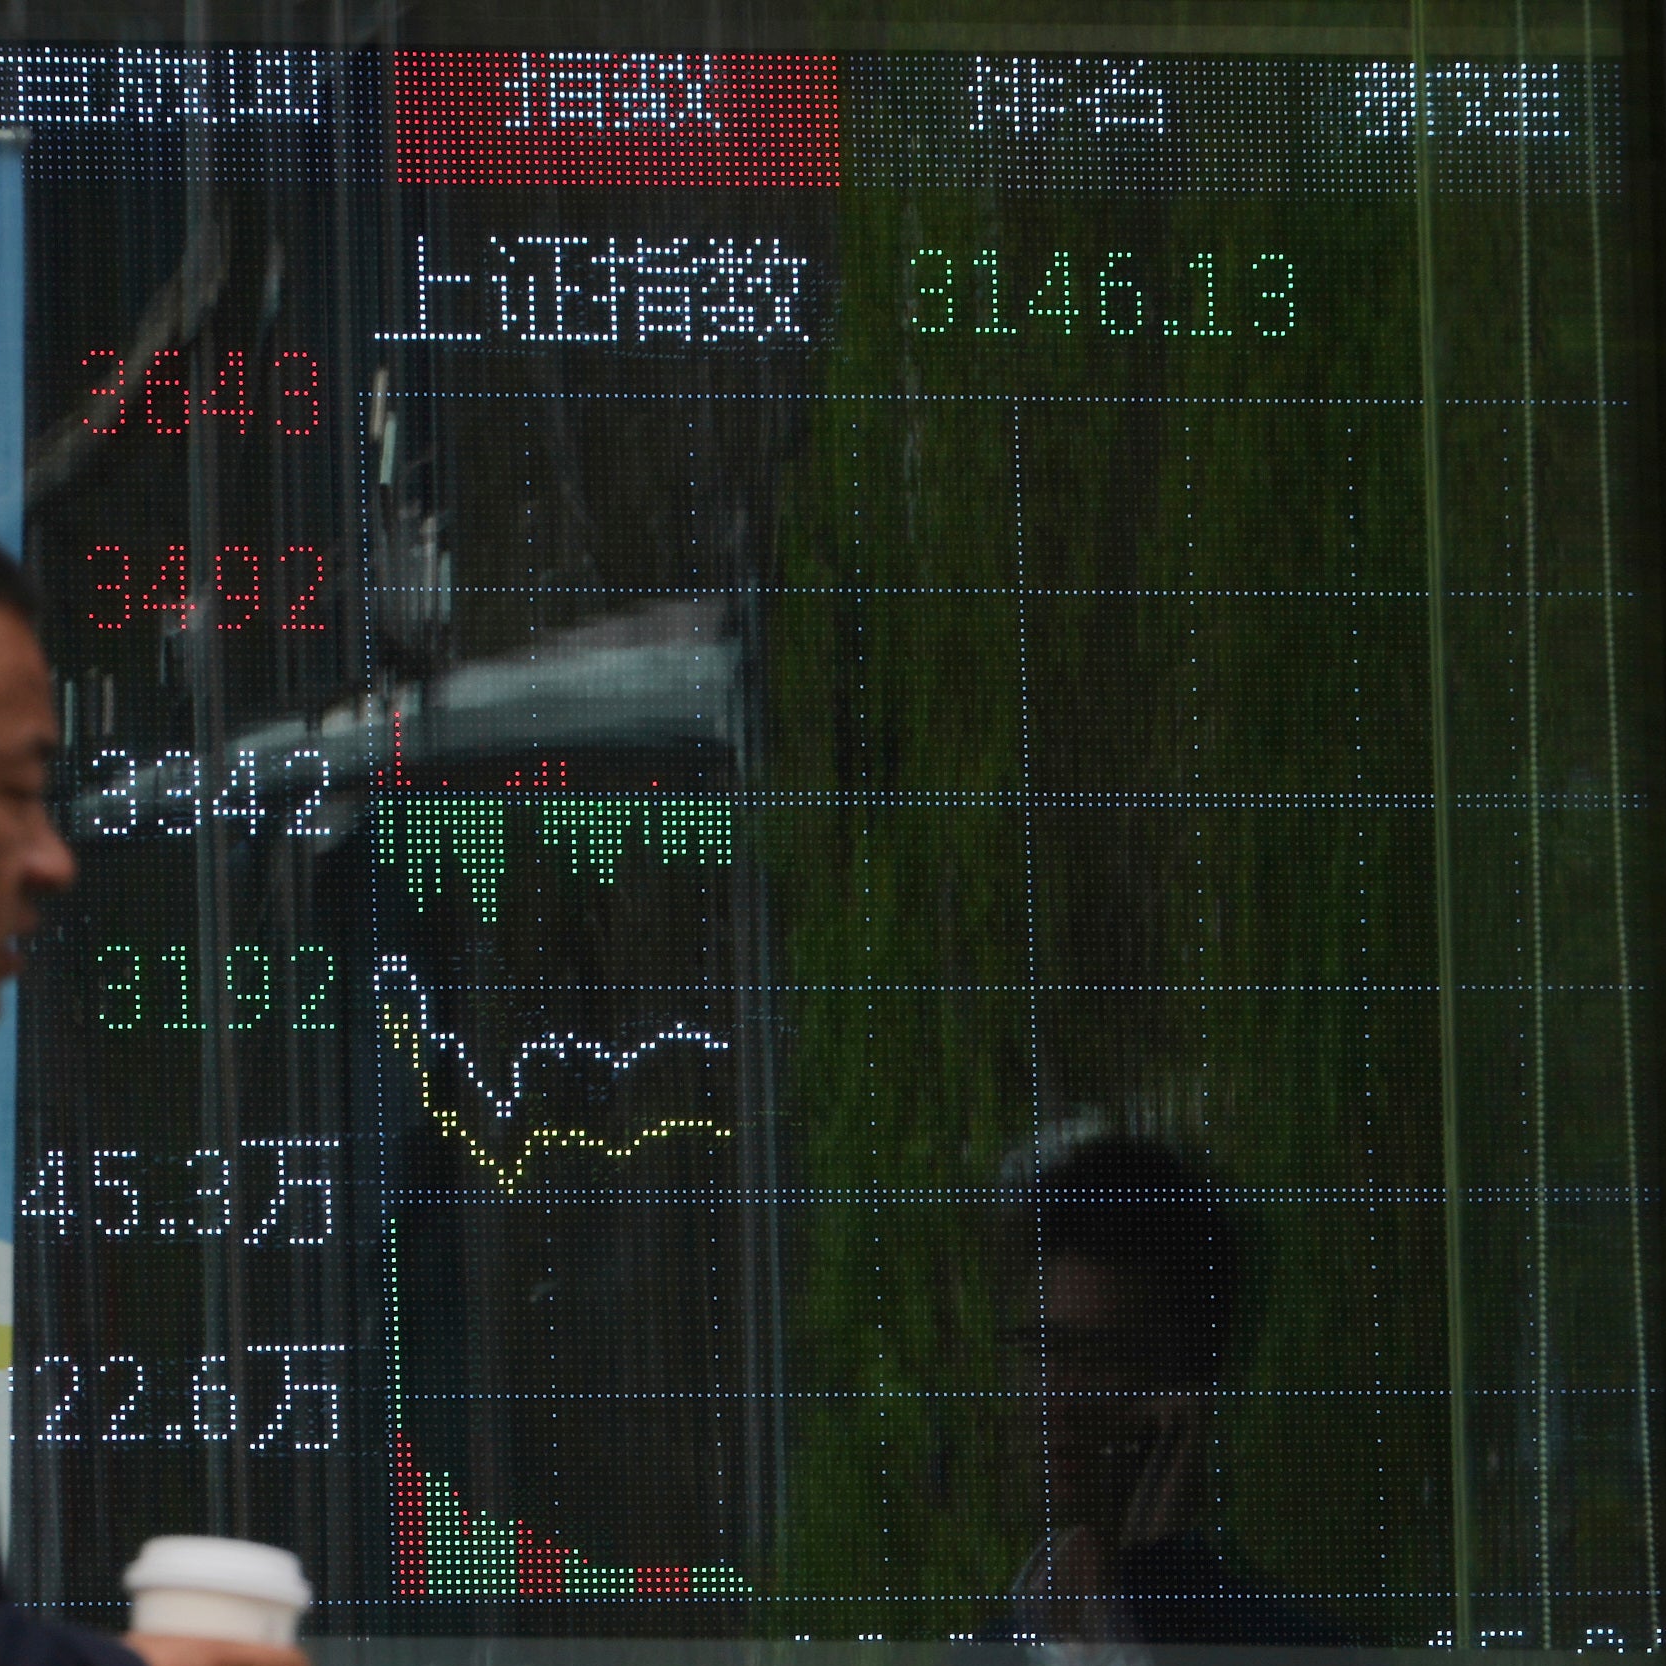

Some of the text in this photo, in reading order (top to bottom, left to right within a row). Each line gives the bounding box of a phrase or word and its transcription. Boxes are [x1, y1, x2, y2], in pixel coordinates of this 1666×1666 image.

[504, 52, 721, 129] 指数
[373, 235, 1297, 343] 上证指数 3146.13
[80, 349, 325, 438] 3643
[86, 547, 327, 634] 3492
[93, 749, 333, 837] 3342
[98, 945, 336, 1031] 3192
[20, 1138, 342, 1247] 45.3万
[9, 1343, 345, 1450] 22.6万
